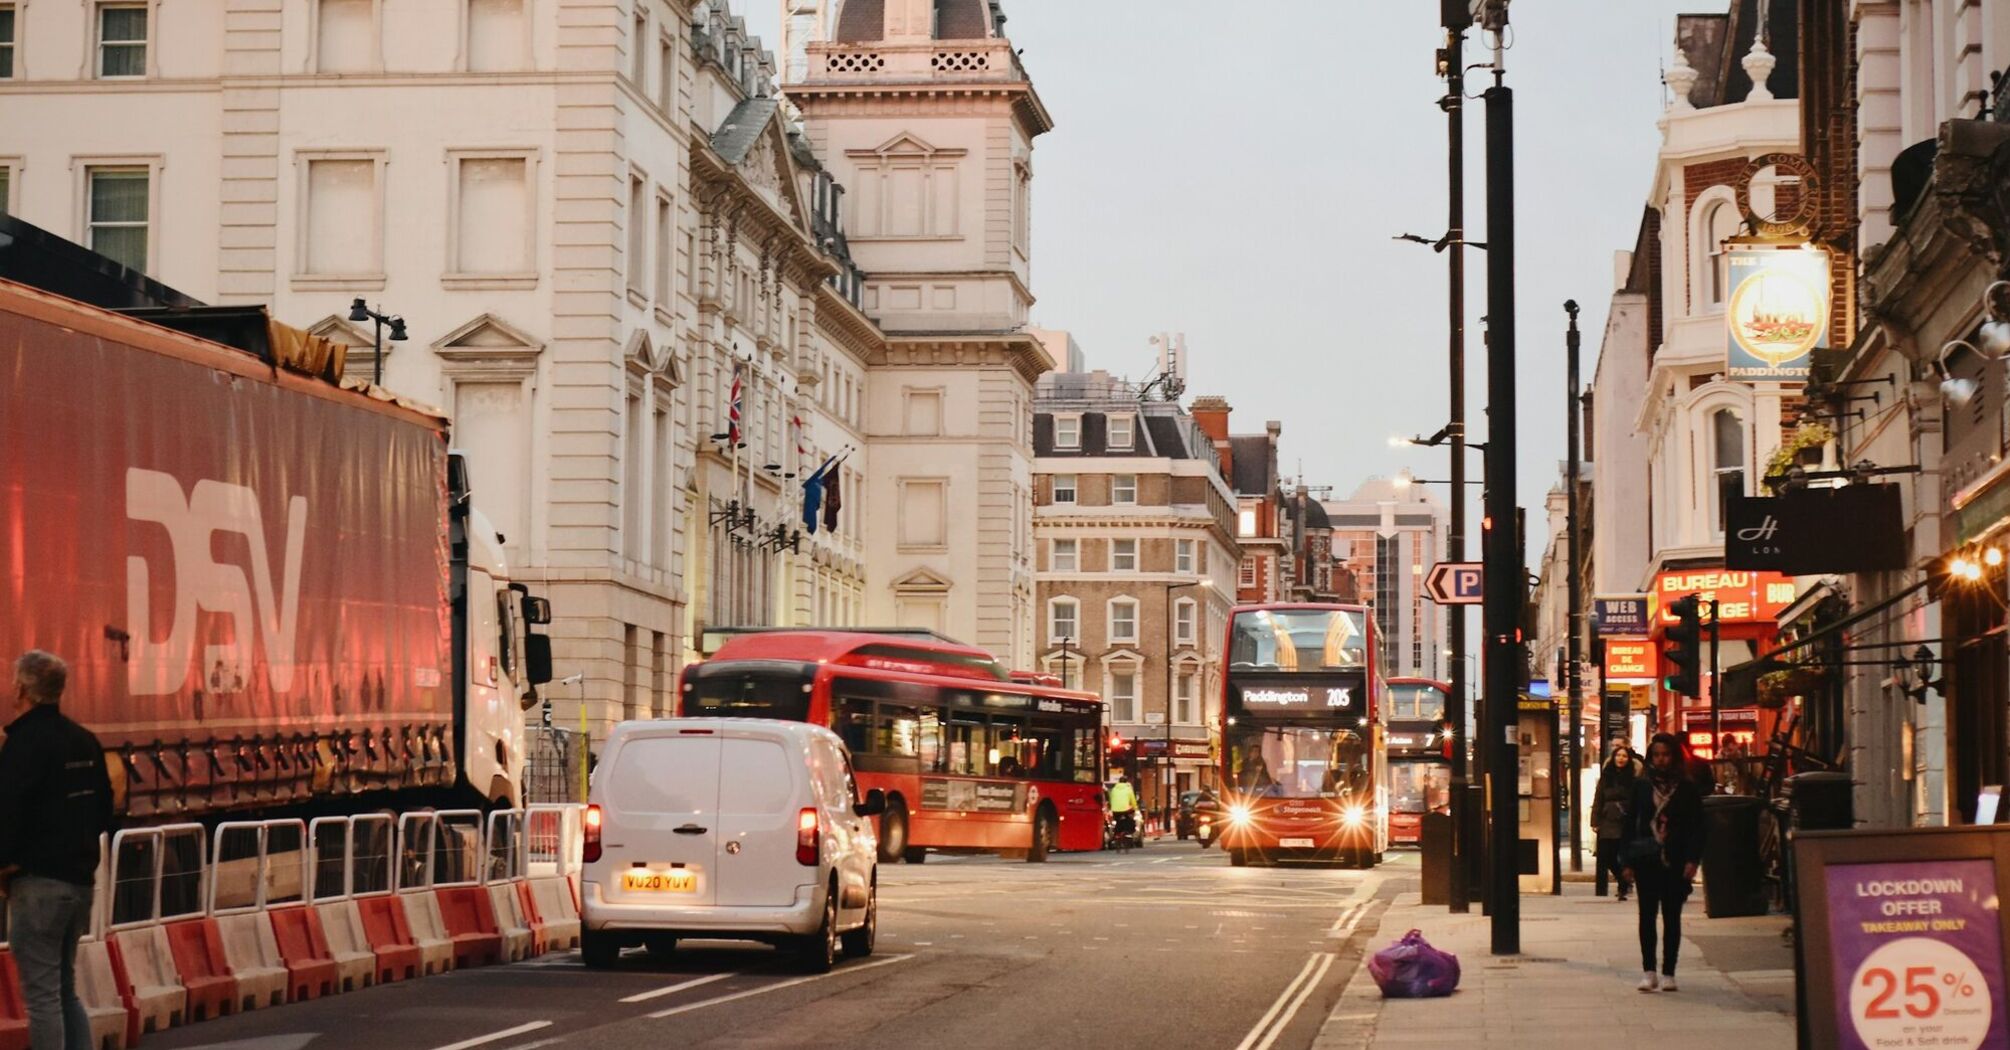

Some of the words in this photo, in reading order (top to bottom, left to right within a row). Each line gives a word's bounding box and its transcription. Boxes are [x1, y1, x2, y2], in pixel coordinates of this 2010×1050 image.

[126, 467, 308, 695] DSV
[1461, 572, 1478, 595] P
[1663, 572, 1748, 591] BUREAU
[1605, 601, 1637, 613] WEB
[1605, 615, 1637, 623] ACCESS
[1611, 646, 1644, 655] BUREAU
[1621, 655, 1633, 663] DE
[1610, 664, 1645, 672] CHANGE
[1243, 690, 1308, 705] Paddington
[1326, 689, 1350, 706] 205
[1425, 733, 1436, 747] 7
[627, 875, 661, 889] VU20
[665, 875, 690, 888] YUV
[1856, 879, 1963, 897] LOCKDOWN
[1882, 900, 1942, 916] OFFER
[1861, 921, 1930, 933] TAKEAWAY
[1931, 919, 1966, 931] ONLY
[1902, 1026, 1917, 1034] on
[1919, 1025, 1944, 1034] your
[1876, 1038, 1904, 1047] Food
[1917, 1036, 1938, 1046] Soft
[1941, 1034, 1969, 1045] drink
